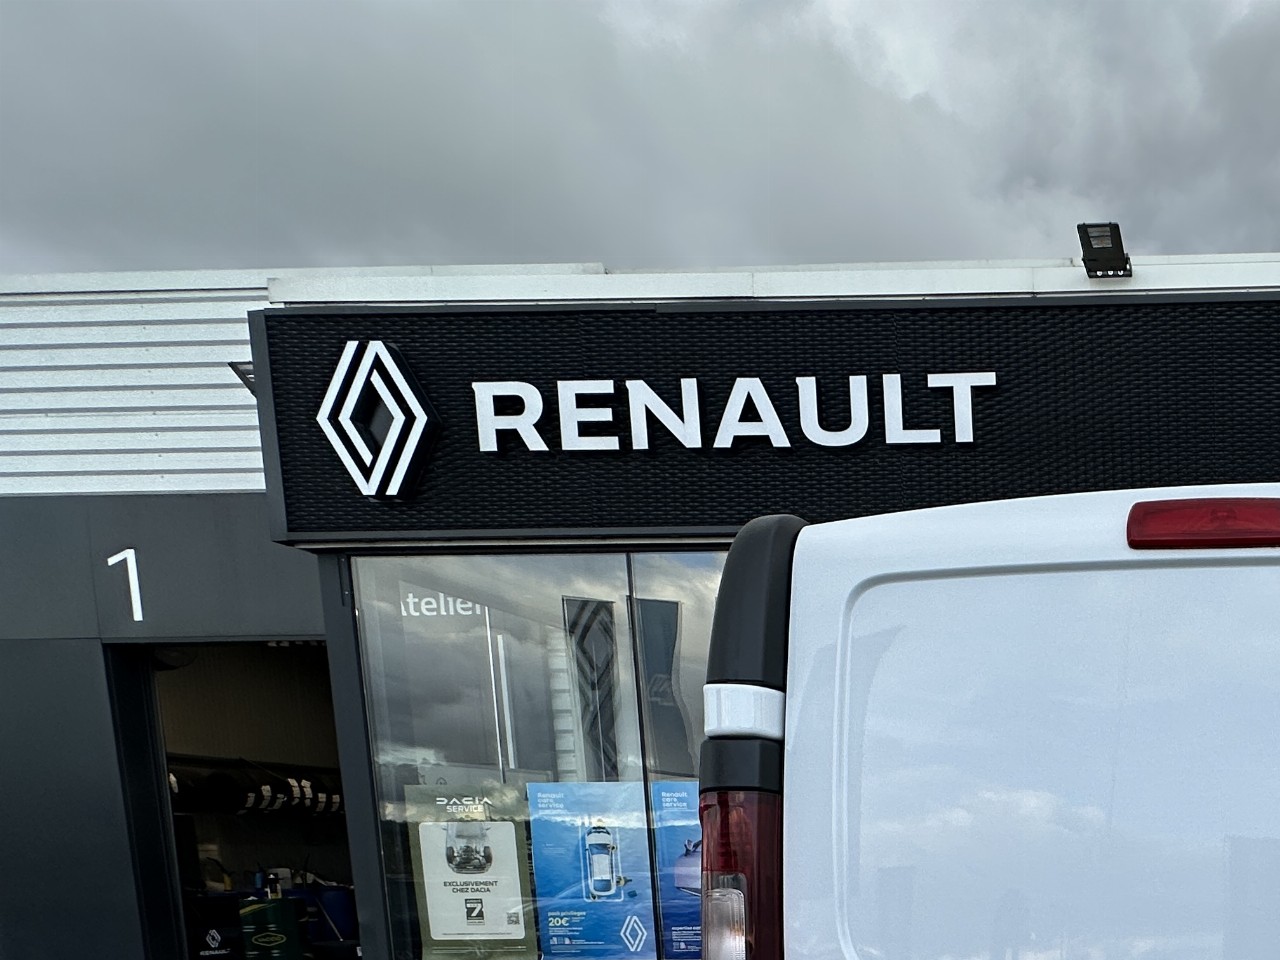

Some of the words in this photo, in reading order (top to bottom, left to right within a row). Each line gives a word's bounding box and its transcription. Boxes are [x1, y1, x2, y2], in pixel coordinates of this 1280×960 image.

[471, 371, 997, 452] RENAULT
[107, 548, 143, 621] 1
[436, 797, 493, 805] DACIA
[446, 805, 484, 813] SERVICE
[548, 917, 570, 927] 20€
